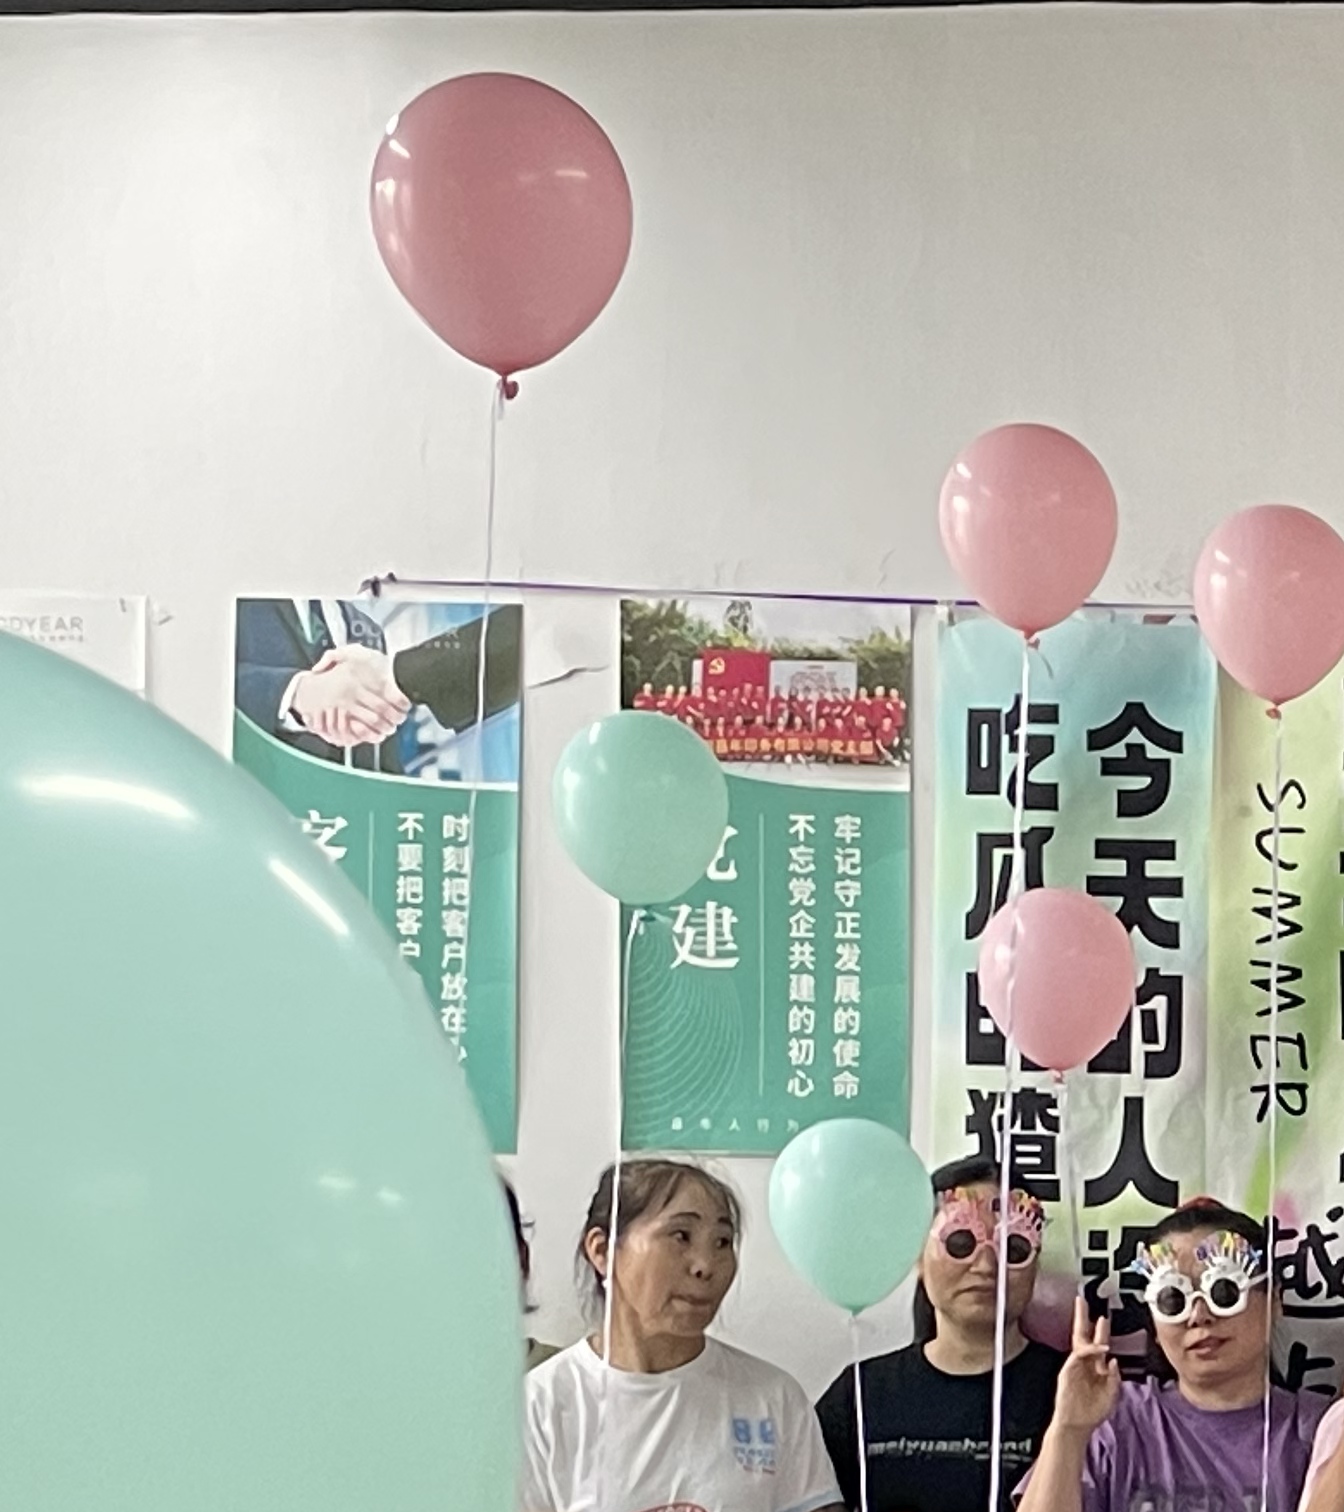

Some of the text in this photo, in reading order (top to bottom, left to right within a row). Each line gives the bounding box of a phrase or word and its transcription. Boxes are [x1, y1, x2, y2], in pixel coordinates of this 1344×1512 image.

[787, 813, 816, 1098] 不忘党企共建的初心
[833, 814, 862, 1100] 牢记守正发展的使命
[1249, 778, 1309, 1123] SUMMER
